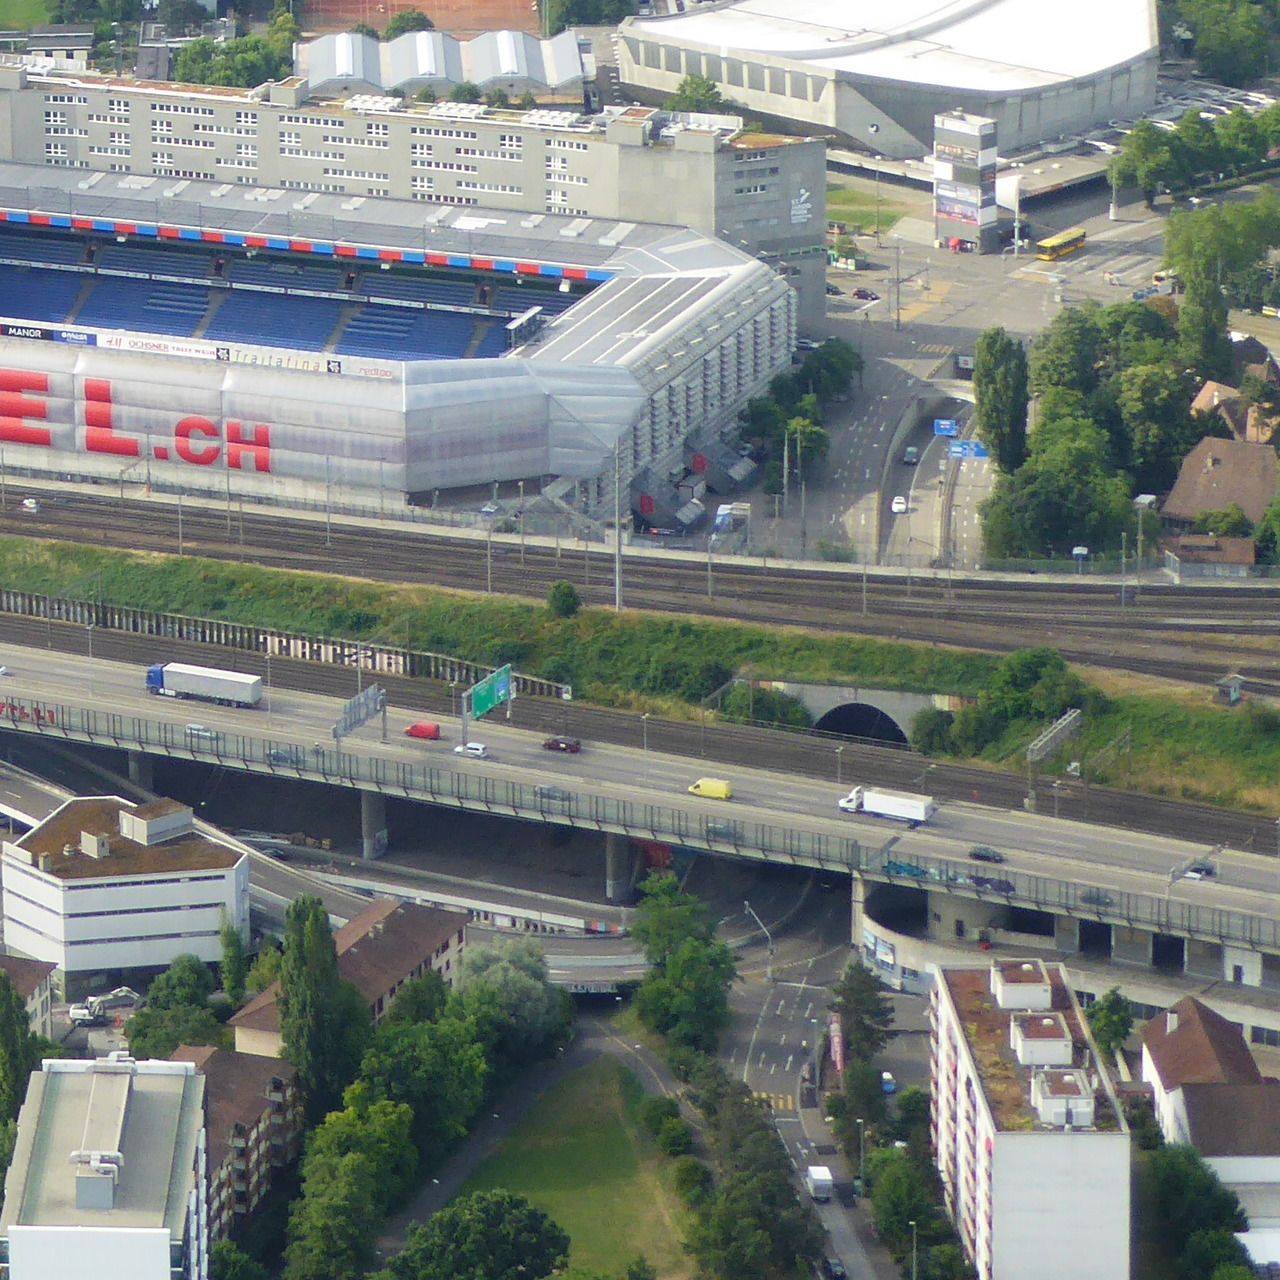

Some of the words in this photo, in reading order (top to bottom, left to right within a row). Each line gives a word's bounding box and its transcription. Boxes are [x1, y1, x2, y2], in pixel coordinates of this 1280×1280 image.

[8, 327, 42, 338] MANOR
[128, 339, 169, 352] OCHSNER
[234, 349, 320, 371] Traitafina
